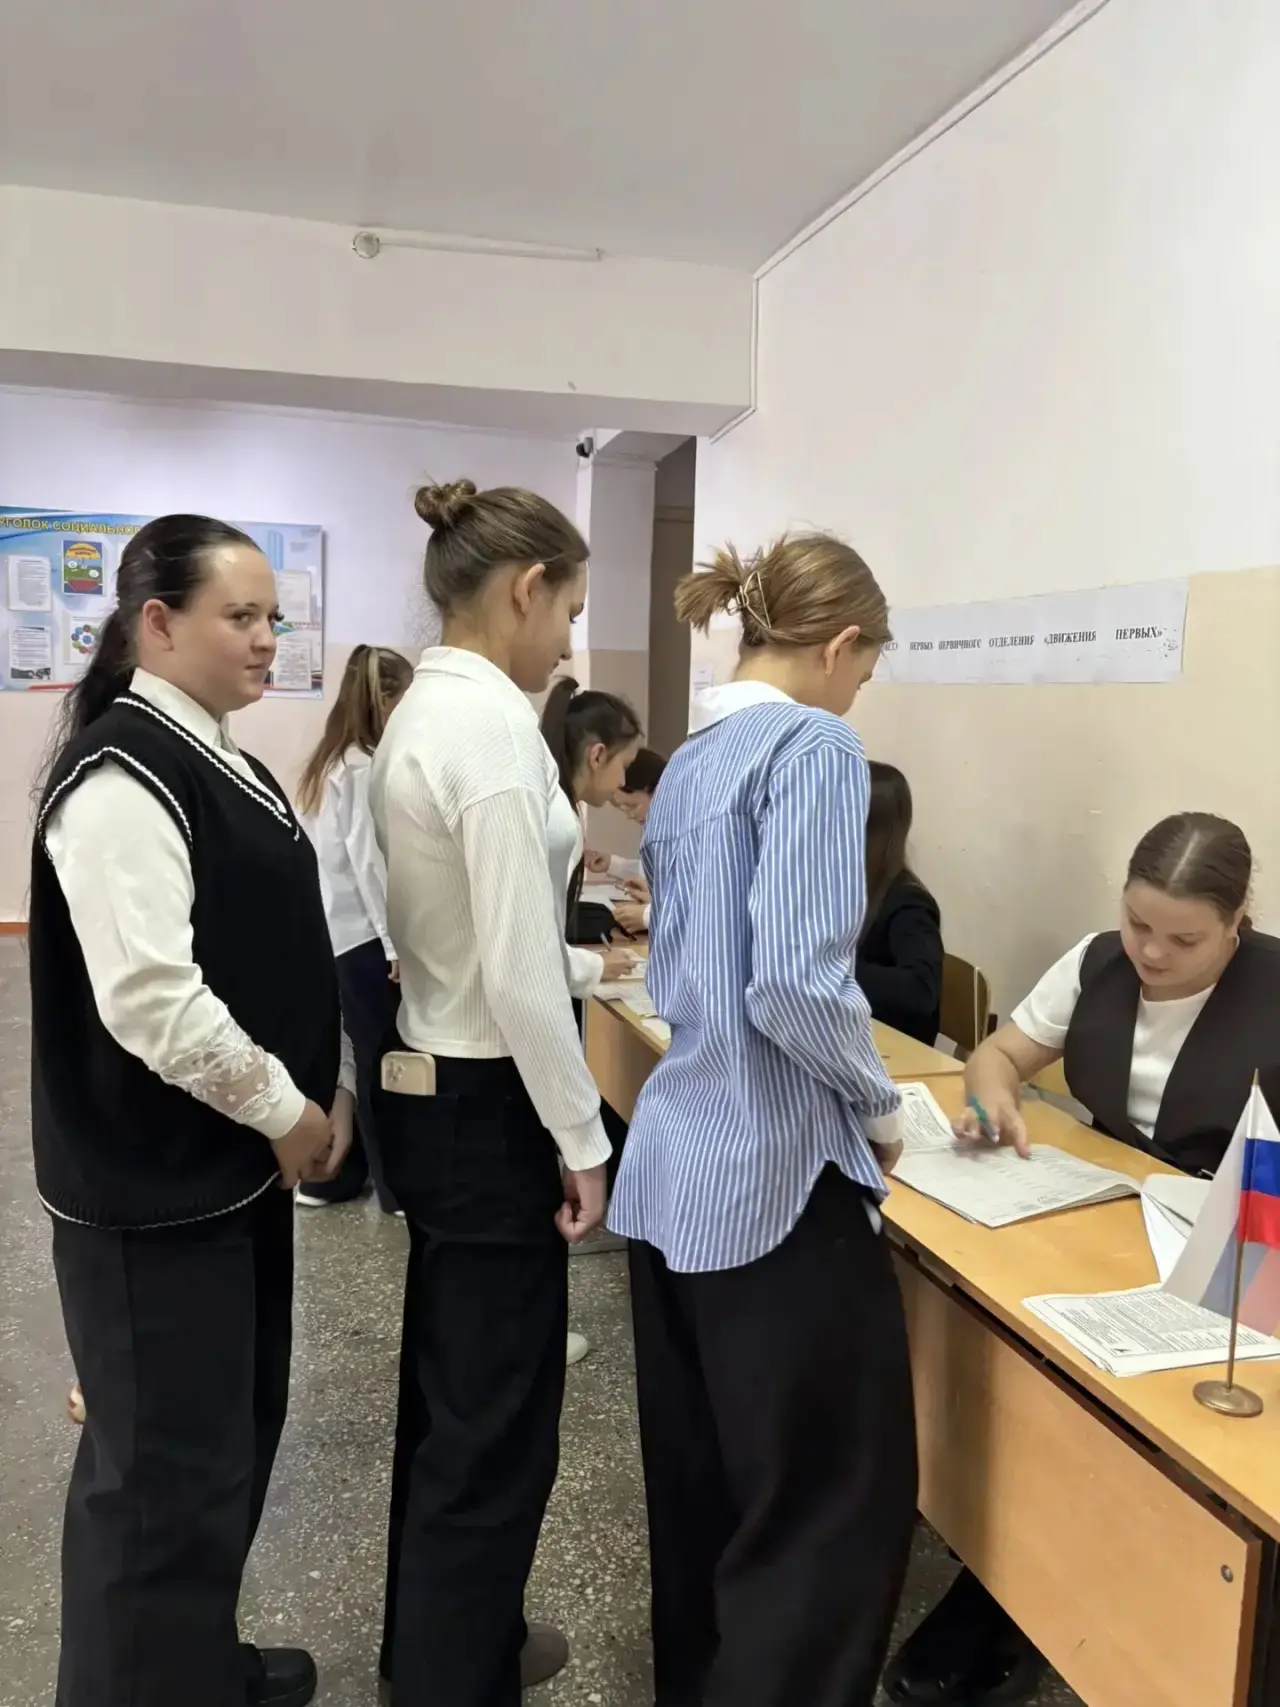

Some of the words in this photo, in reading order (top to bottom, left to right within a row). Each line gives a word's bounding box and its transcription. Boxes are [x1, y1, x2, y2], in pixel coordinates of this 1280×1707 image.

[0, 516, 49, 530] УГОЛОК
[988, 635, 1035, 648] ОТДЕЛЕНИЯ
[1043, 631, 1097, 645] «ДВИЖЕНИЯ
[1115, 626, 1163, 640] ПЕРВЫХ»
